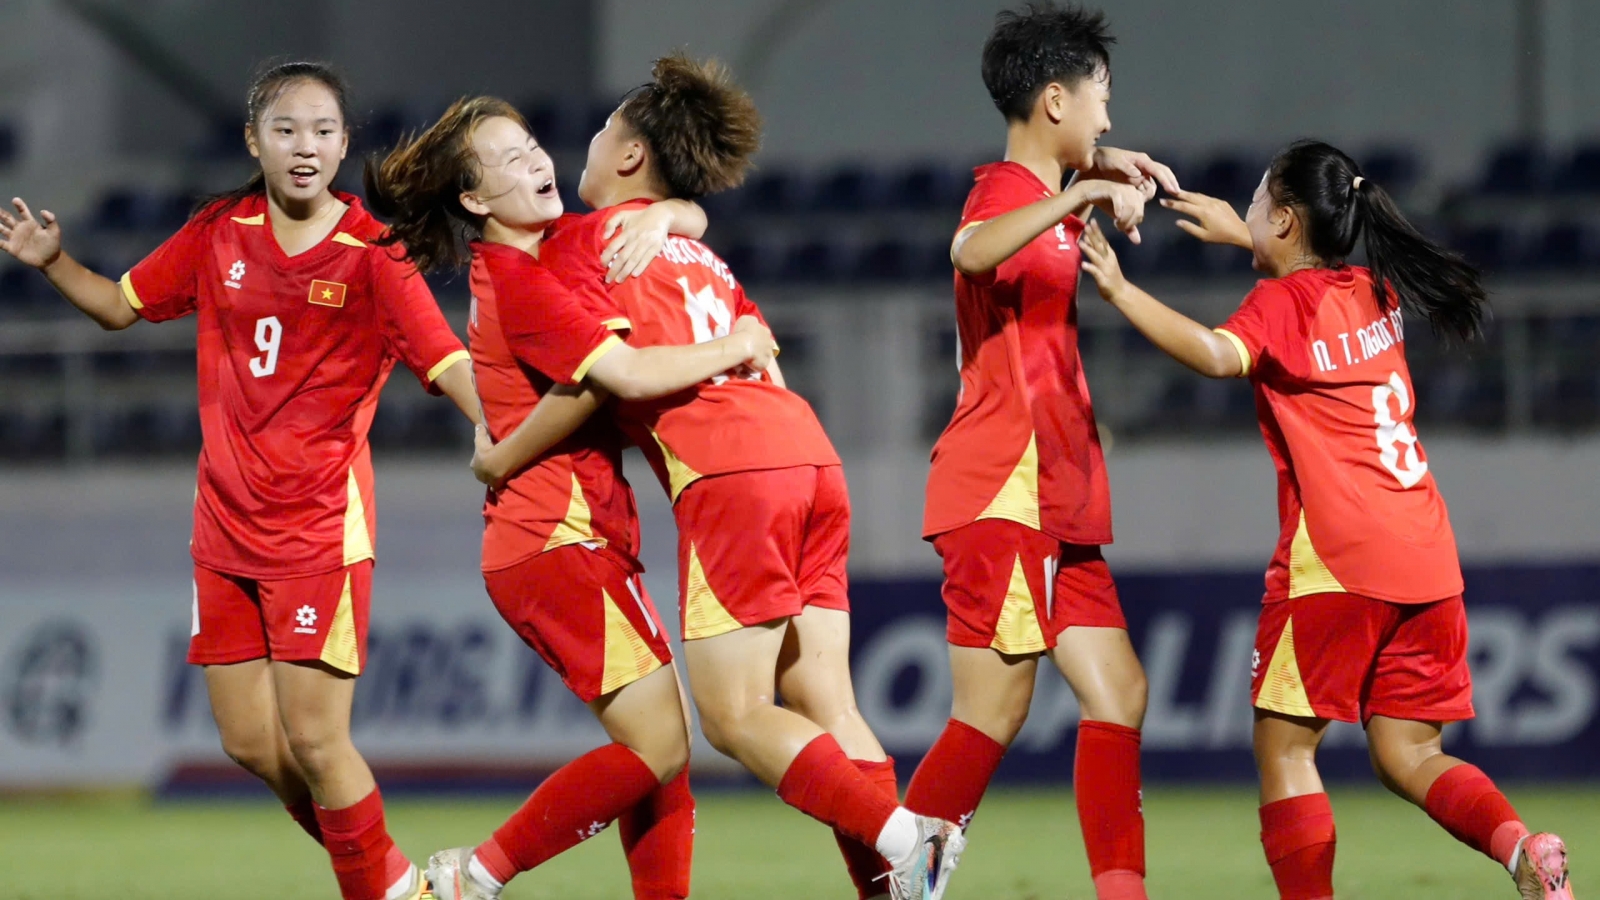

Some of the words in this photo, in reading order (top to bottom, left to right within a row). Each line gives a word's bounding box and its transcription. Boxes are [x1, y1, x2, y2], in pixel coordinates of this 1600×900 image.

[248, 316, 283, 378] 9
[1312, 340, 1337, 371] N.
[1338, 333, 1360, 365] T.
[1356, 317, 1395, 360] NGOC
